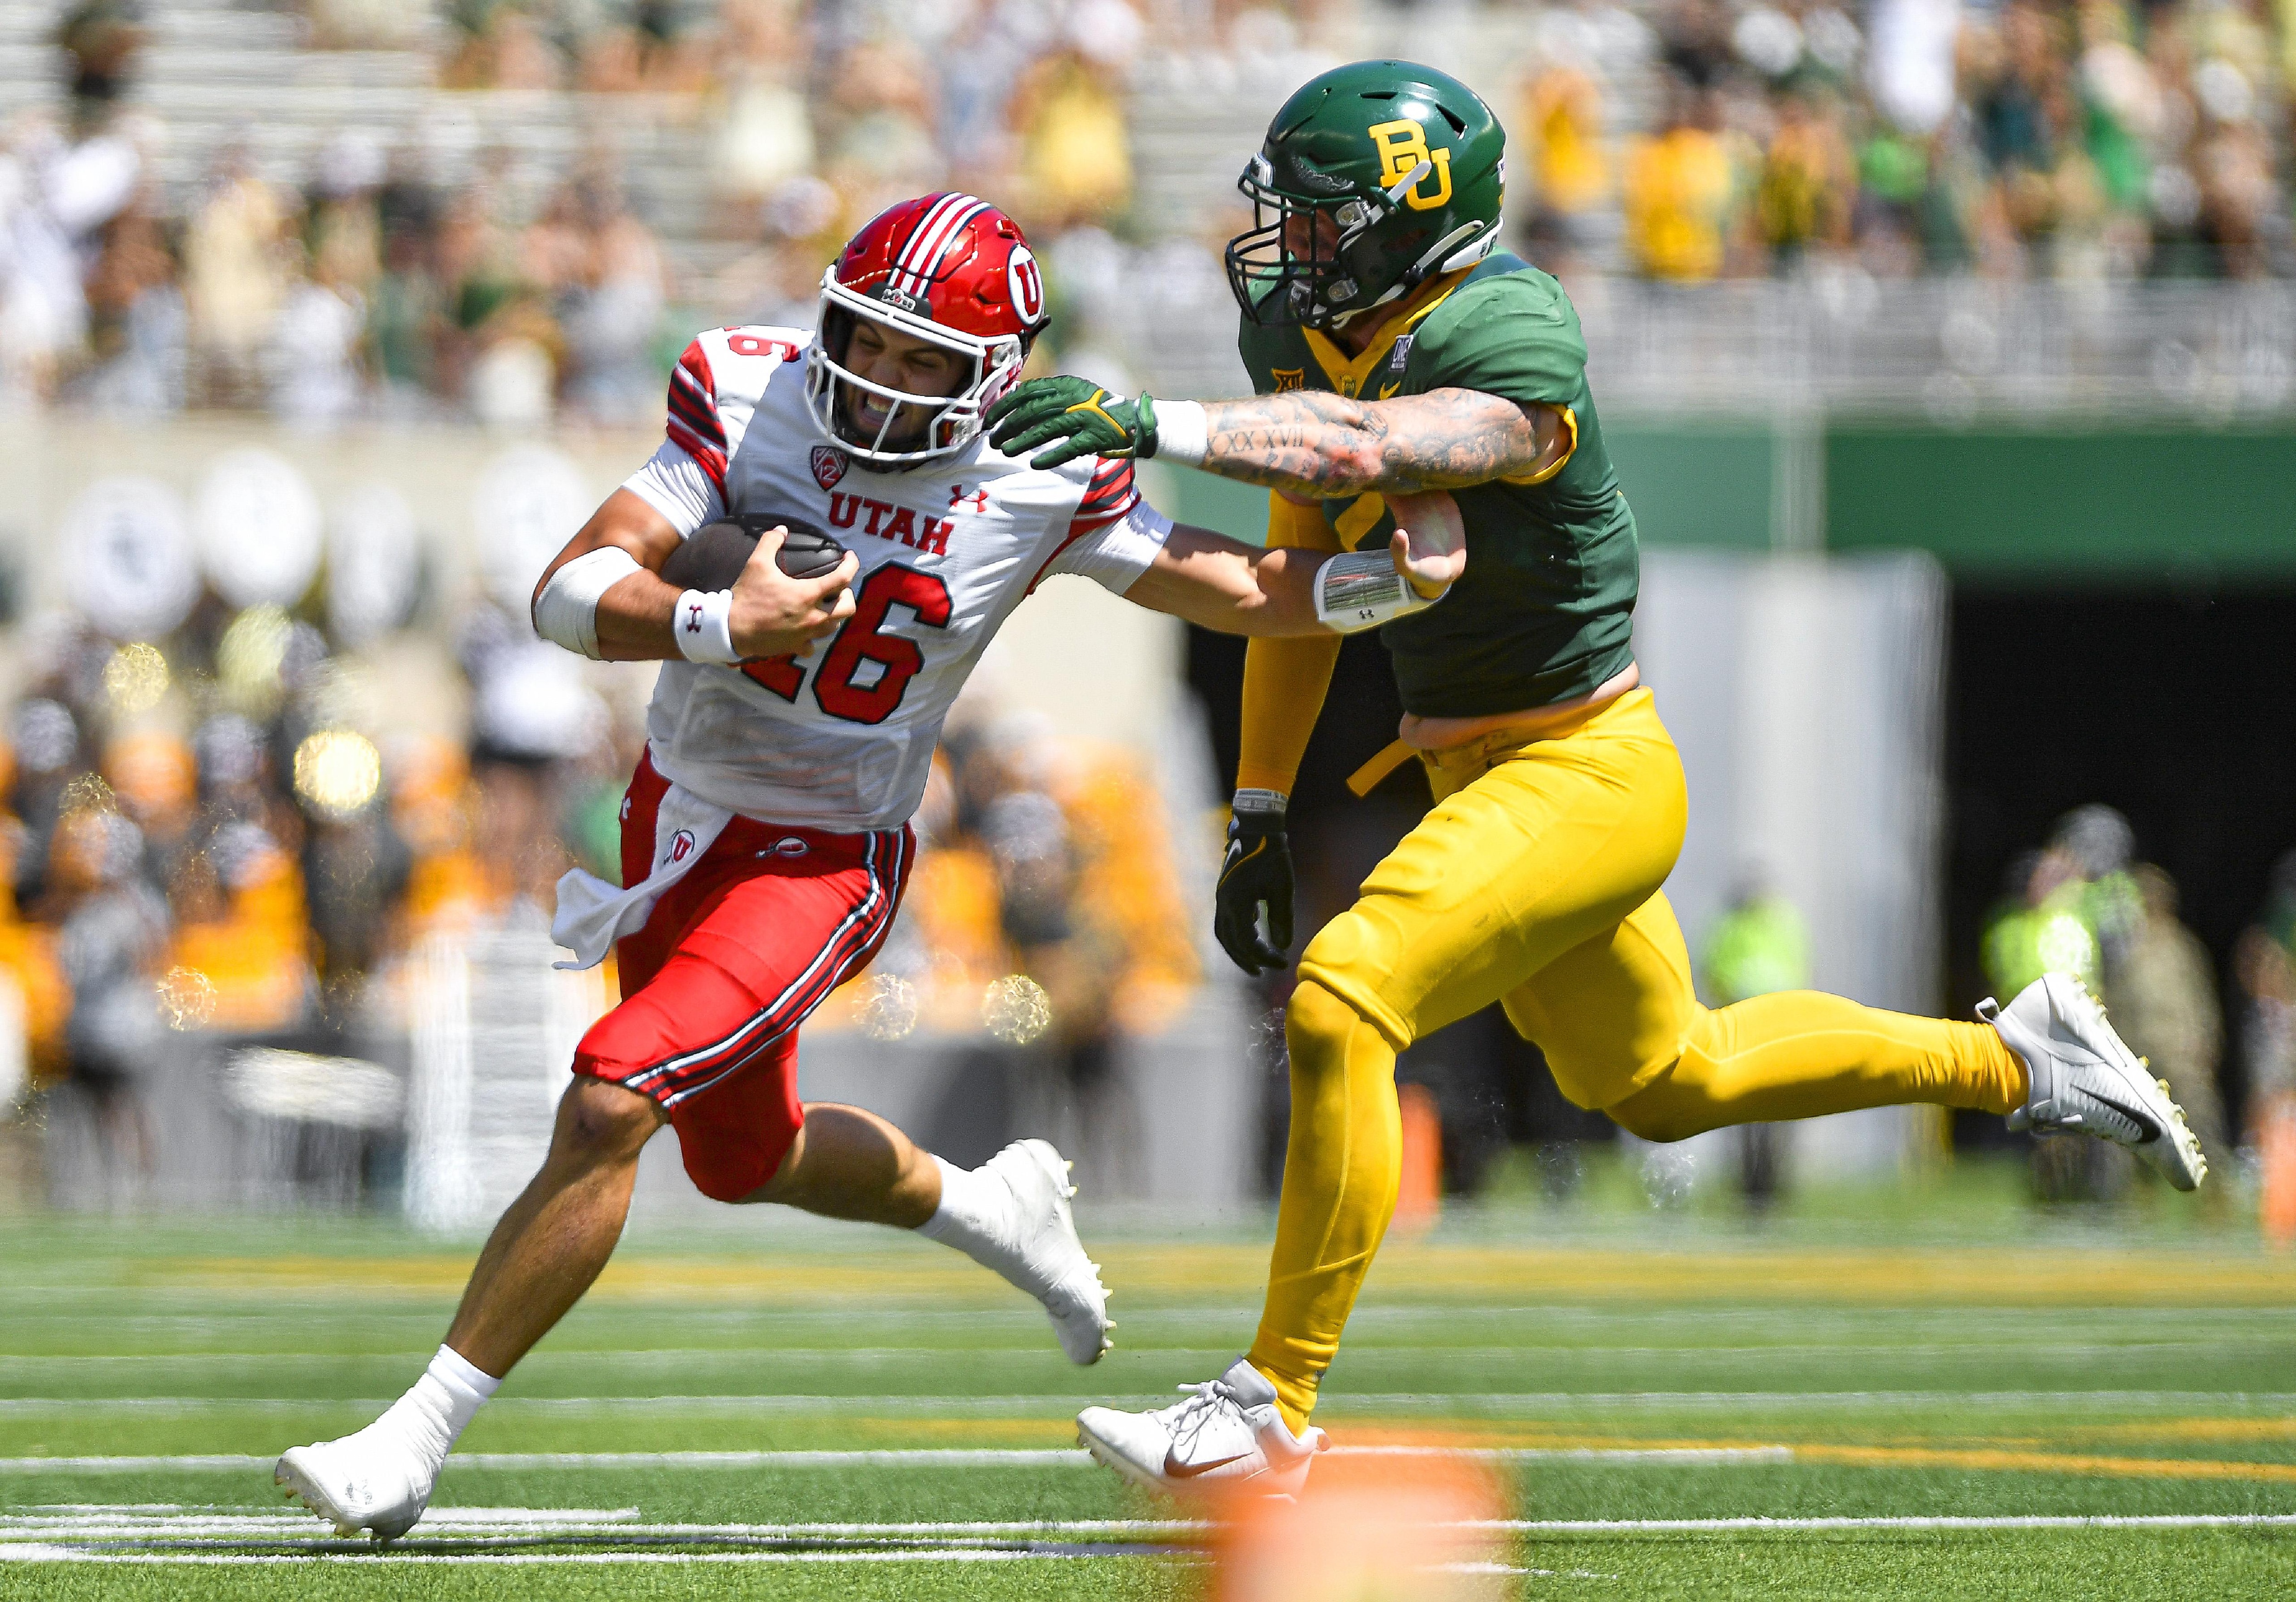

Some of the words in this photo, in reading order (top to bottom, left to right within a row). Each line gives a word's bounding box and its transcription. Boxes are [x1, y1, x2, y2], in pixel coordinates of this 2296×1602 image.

[1368, 118, 1452, 211] BU
[1013, 257, 1040, 317] U
[724, 326, 802, 362] 6
[829, 491, 955, 556] UTAH
